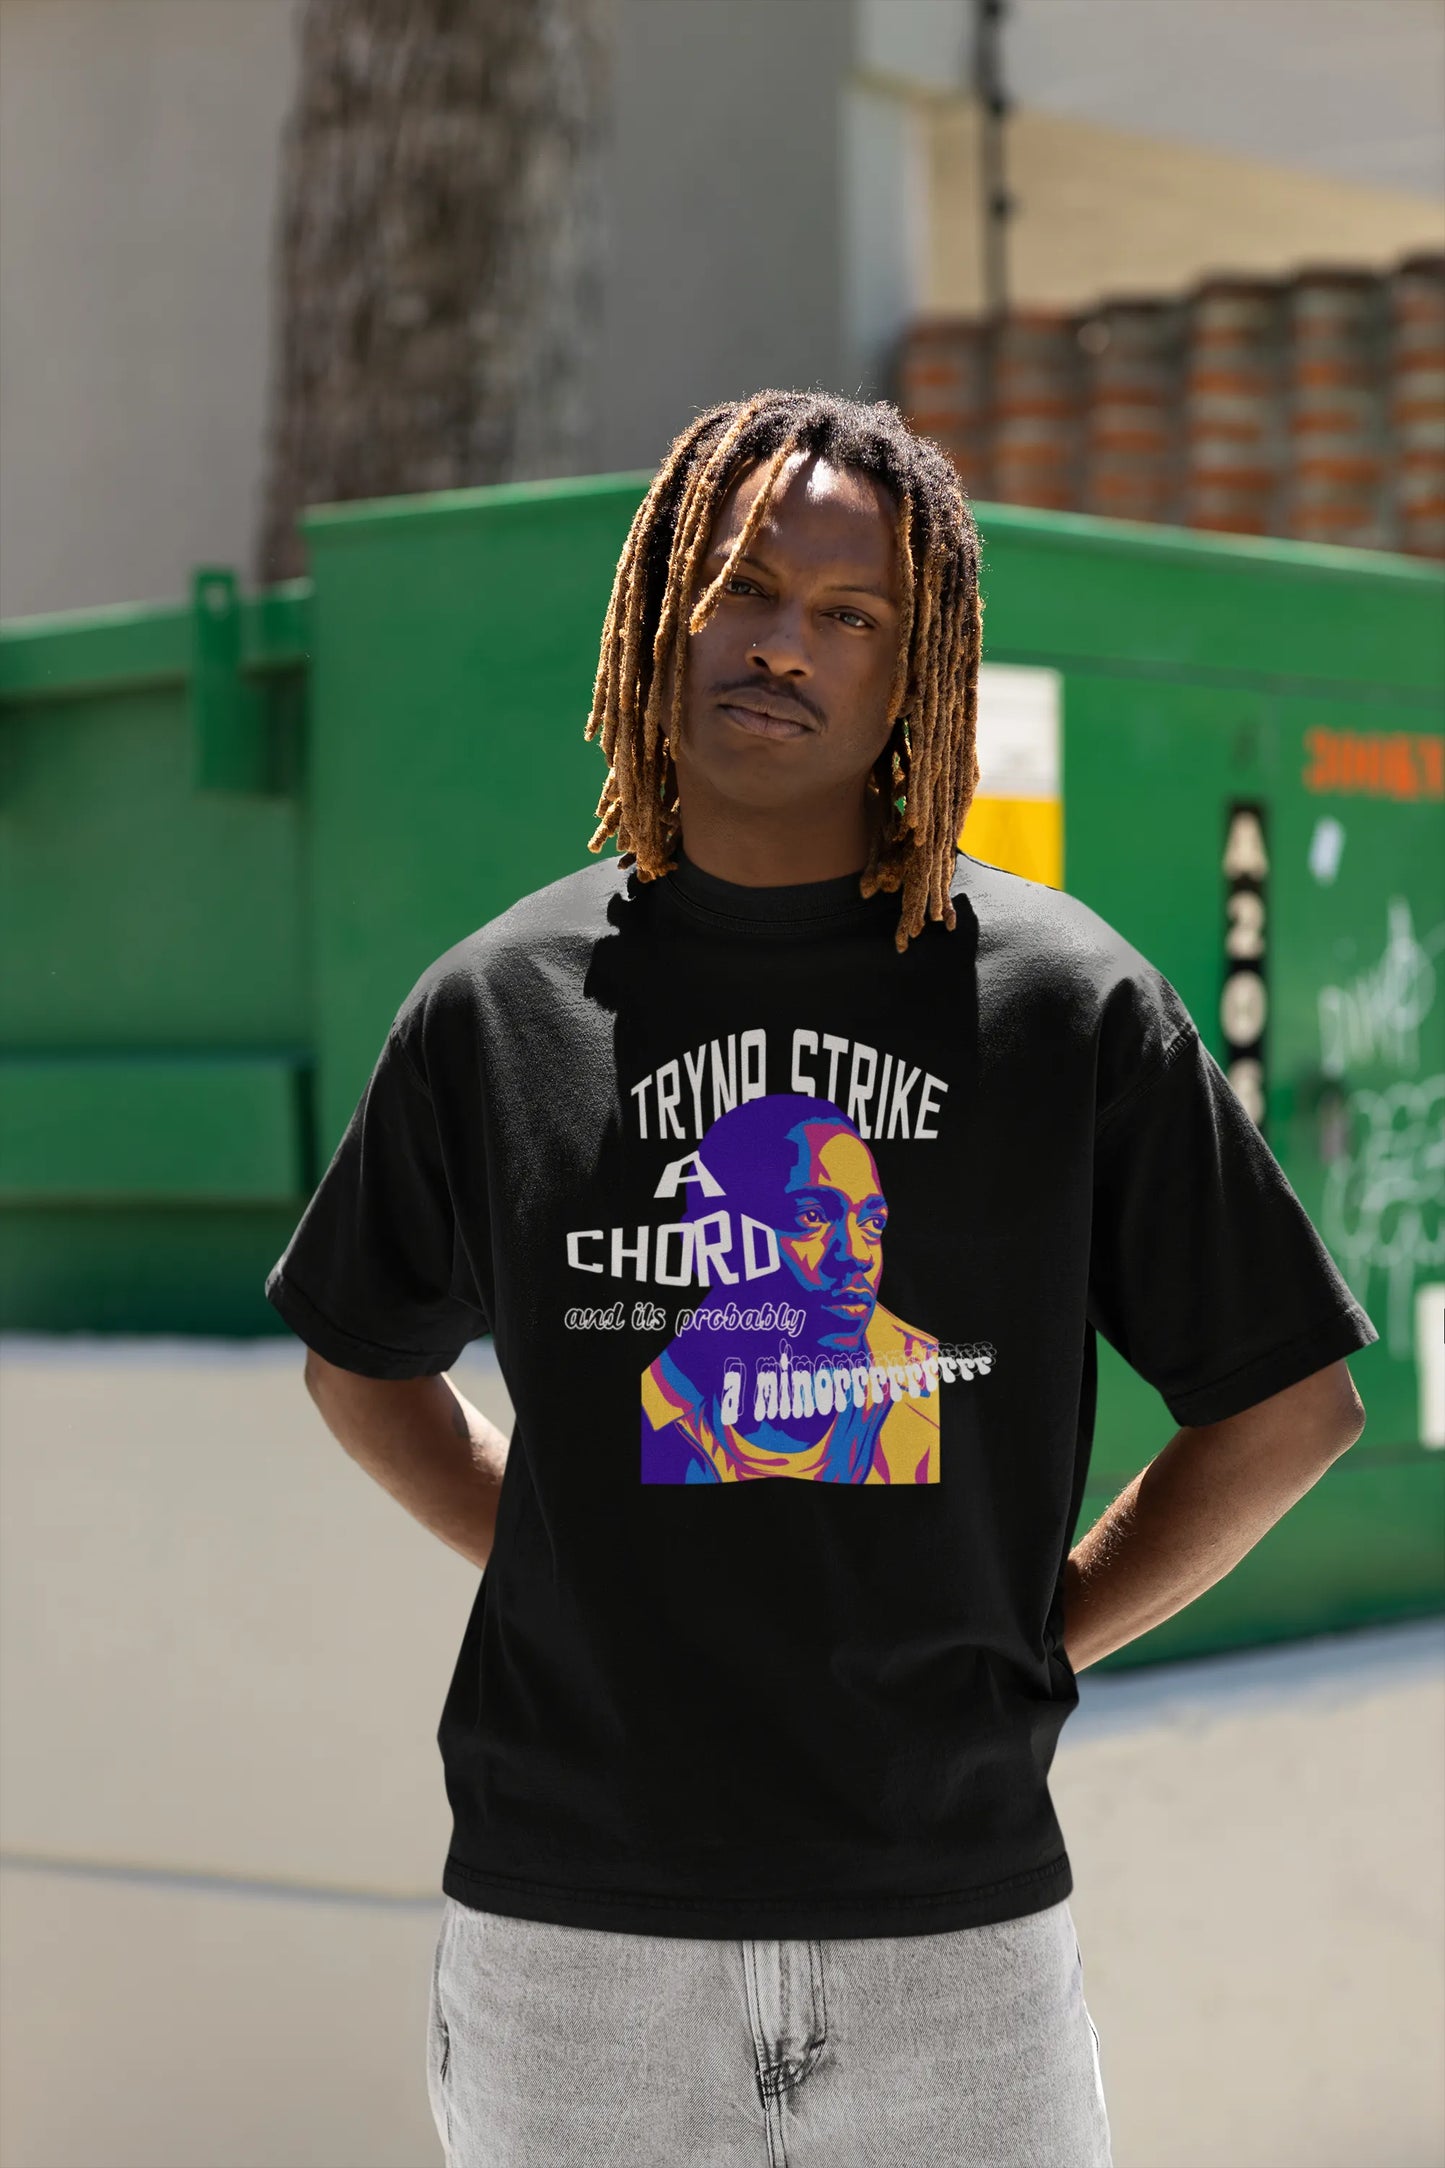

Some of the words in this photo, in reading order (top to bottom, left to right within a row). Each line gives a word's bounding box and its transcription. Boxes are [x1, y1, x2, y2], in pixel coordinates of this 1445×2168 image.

[790, 1027, 949, 1140] STRIKE
[653, 1150, 727, 1198] A
[566, 1209, 781, 1287] CHORD
[564, 1301, 626, 1330] and
[631, 1301, 667, 1331] its
[675, 1302, 807, 1338] probably
[720, 1361, 744, 1426] a
